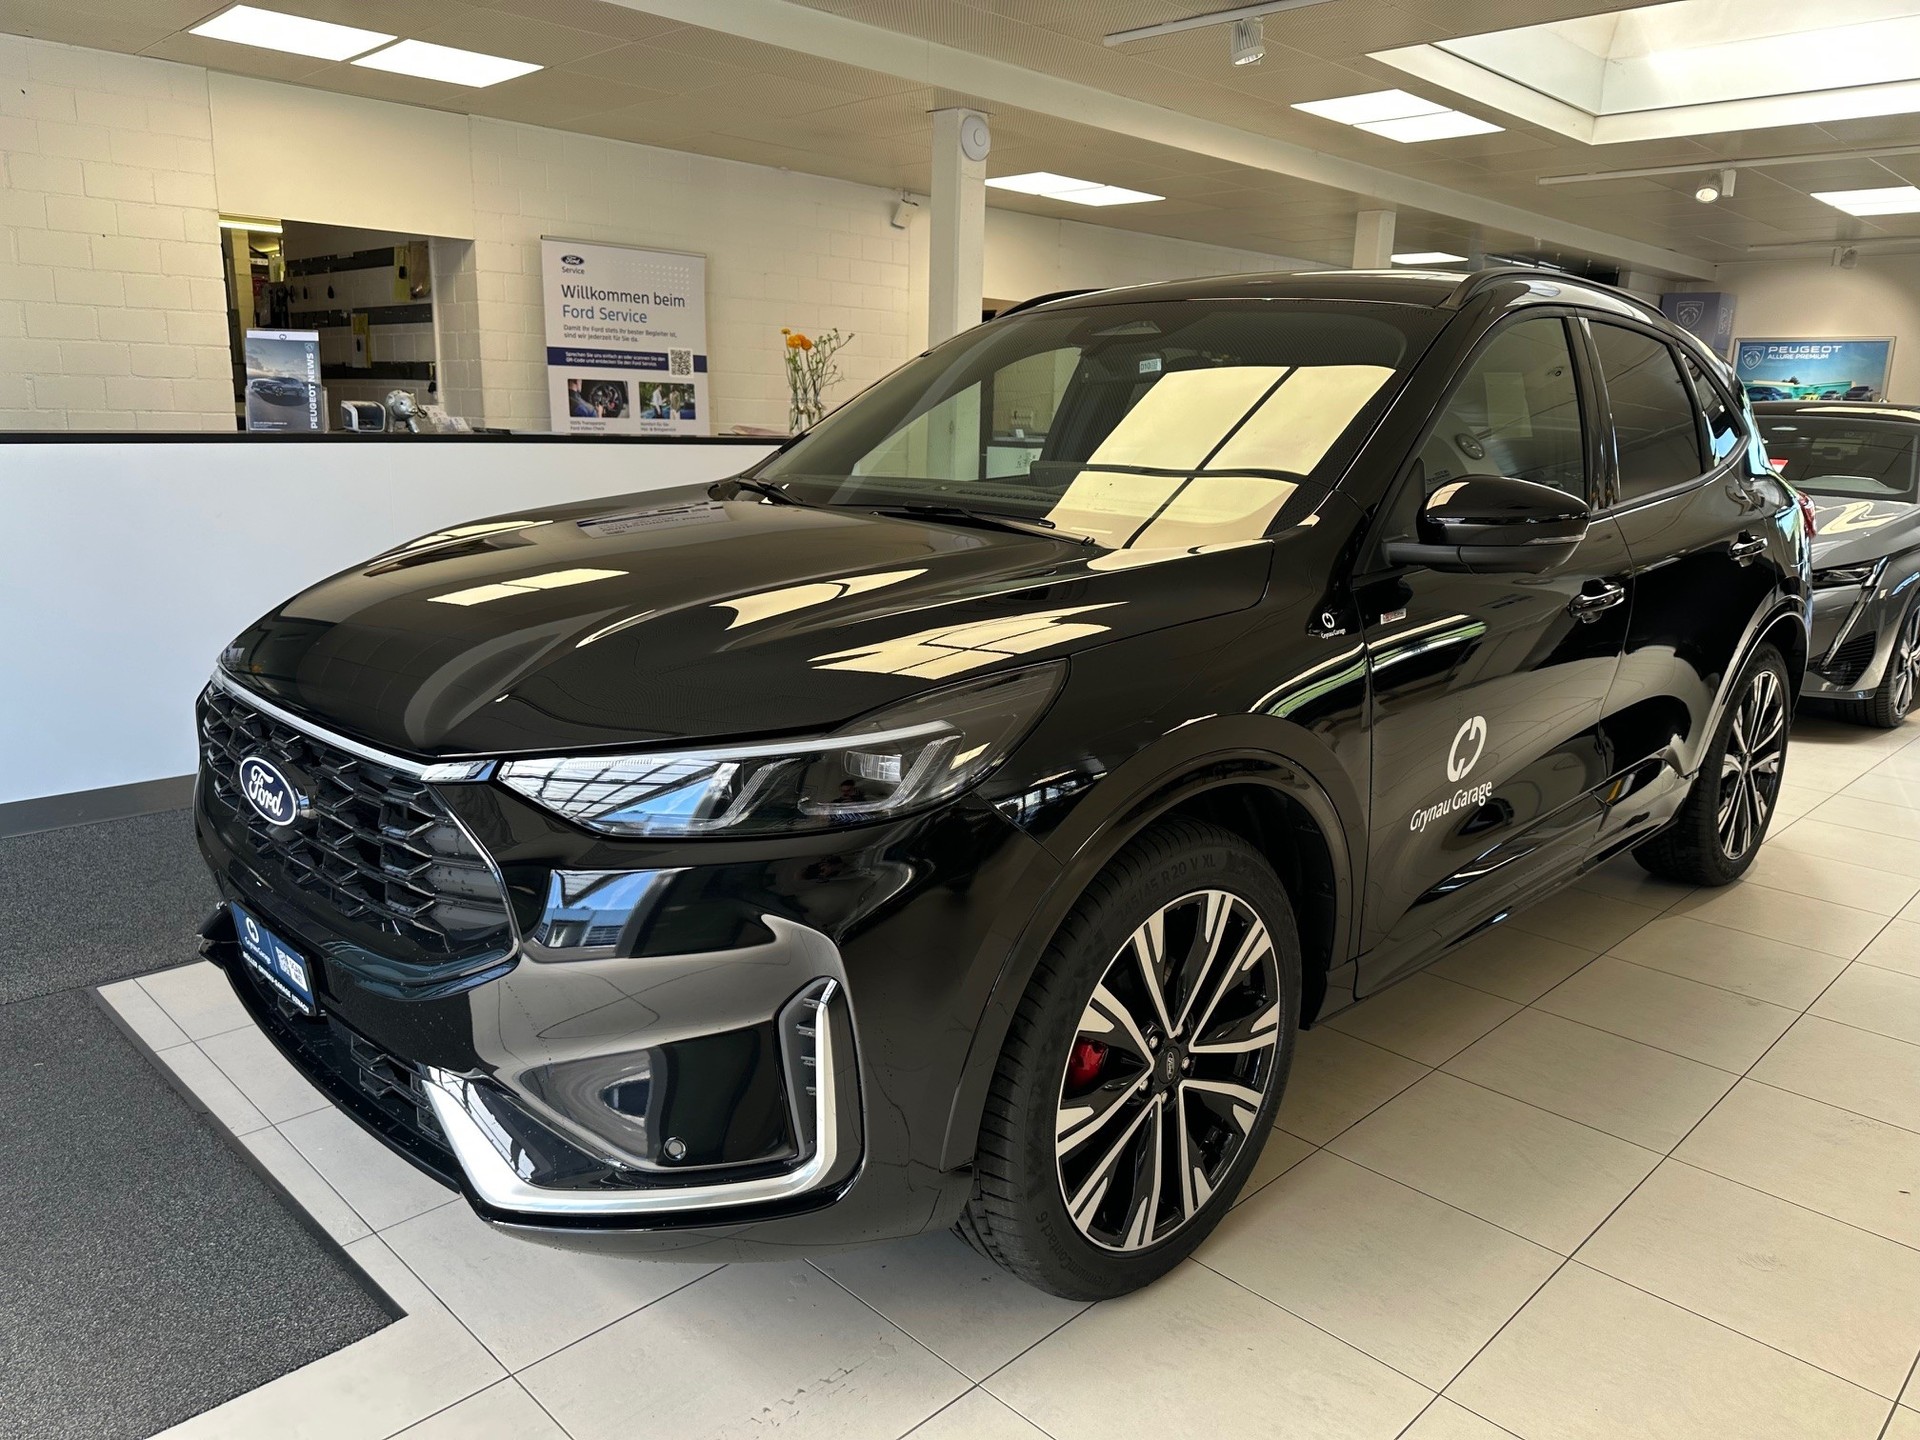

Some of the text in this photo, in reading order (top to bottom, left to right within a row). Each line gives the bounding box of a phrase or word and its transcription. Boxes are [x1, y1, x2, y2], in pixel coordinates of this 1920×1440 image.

[561, 265, 585, 274] Service
[561, 284, 685, 308] Willkommen beim
[562, 304, 647, 323] Ford Service
[588, 333, 611, 341] jederzeit
[1768, 345, 1842, 354] PEUGEOT
[306, 353, 318, 429] PEUGEOT NEWS
[249, 765, 283, 816] Ford
[1410, 781, 1492, 833] Grynau Garage
[1202, 853, 1216, 868] XL
[1036, 1211, 1114, 1288] PremiumContact 6
